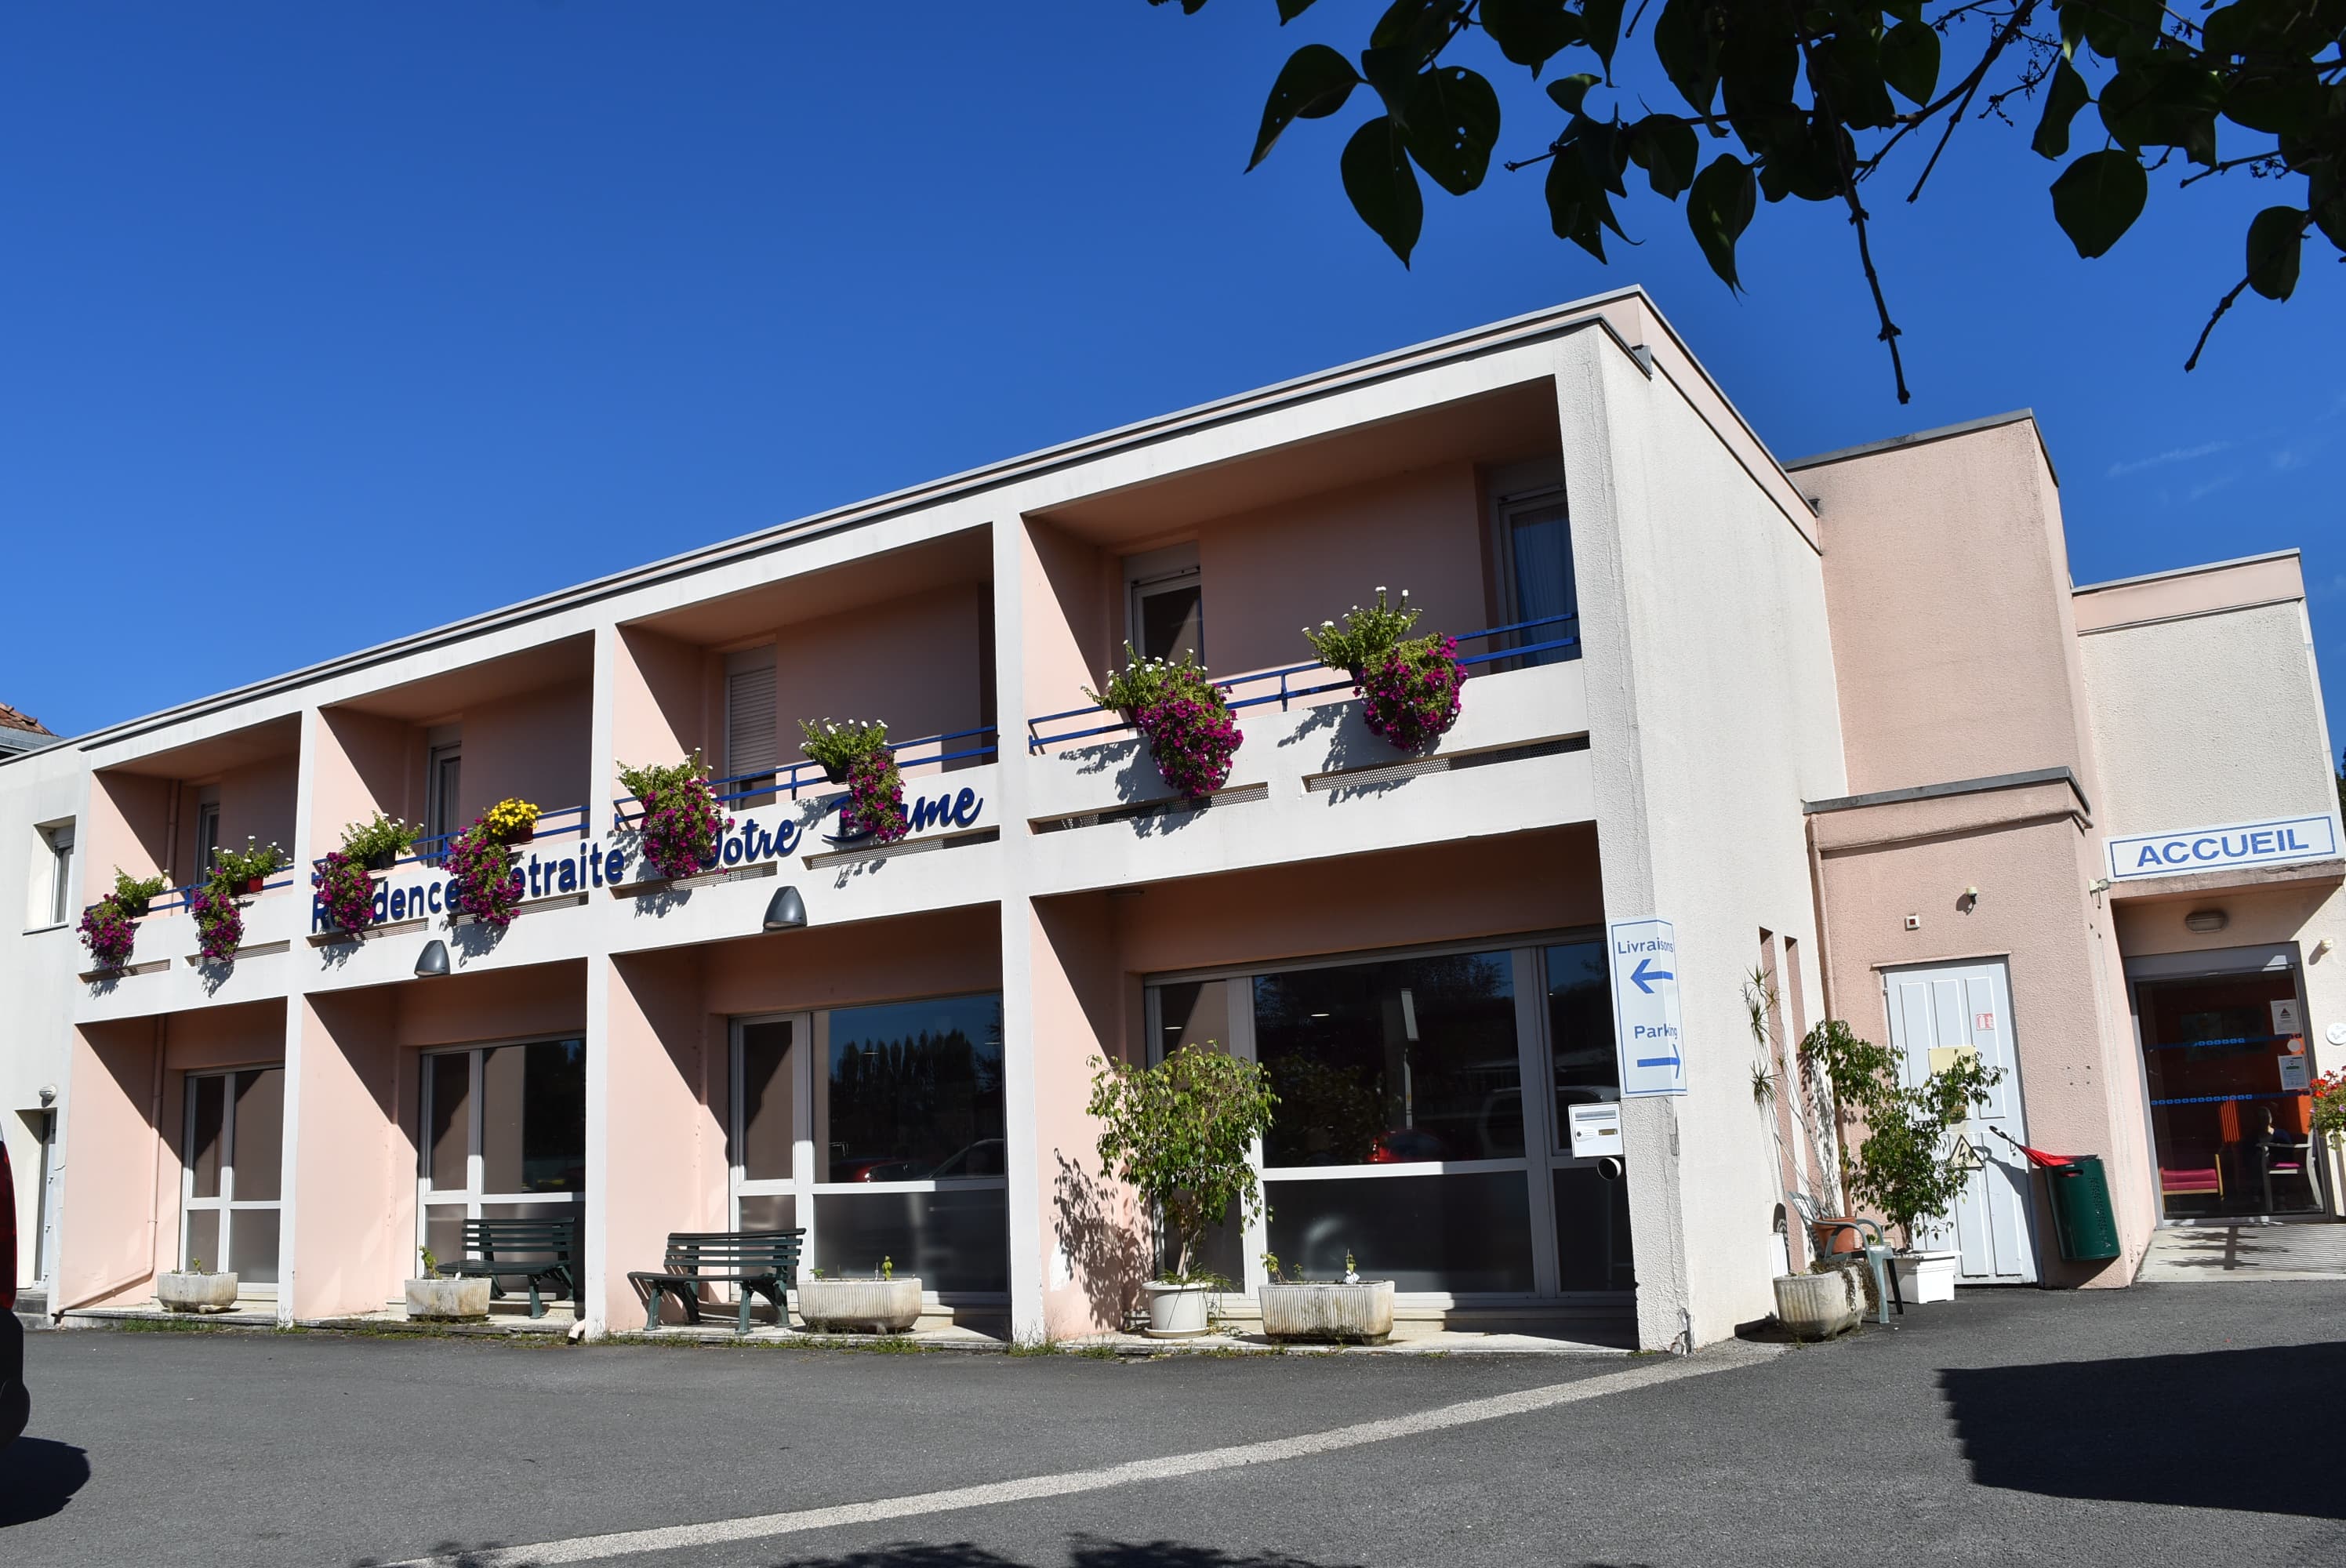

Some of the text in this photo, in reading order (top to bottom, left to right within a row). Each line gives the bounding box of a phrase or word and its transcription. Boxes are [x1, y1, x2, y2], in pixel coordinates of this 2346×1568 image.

[2137, 829, 2309, 867] ACCUEIL
[312, 879, 463, 934] Rdence
[508, 842, 625, 901] etraite
[1618, 938, 1672, 954] Livraisons
[1634, 1024, 1677, 1040] Parking
